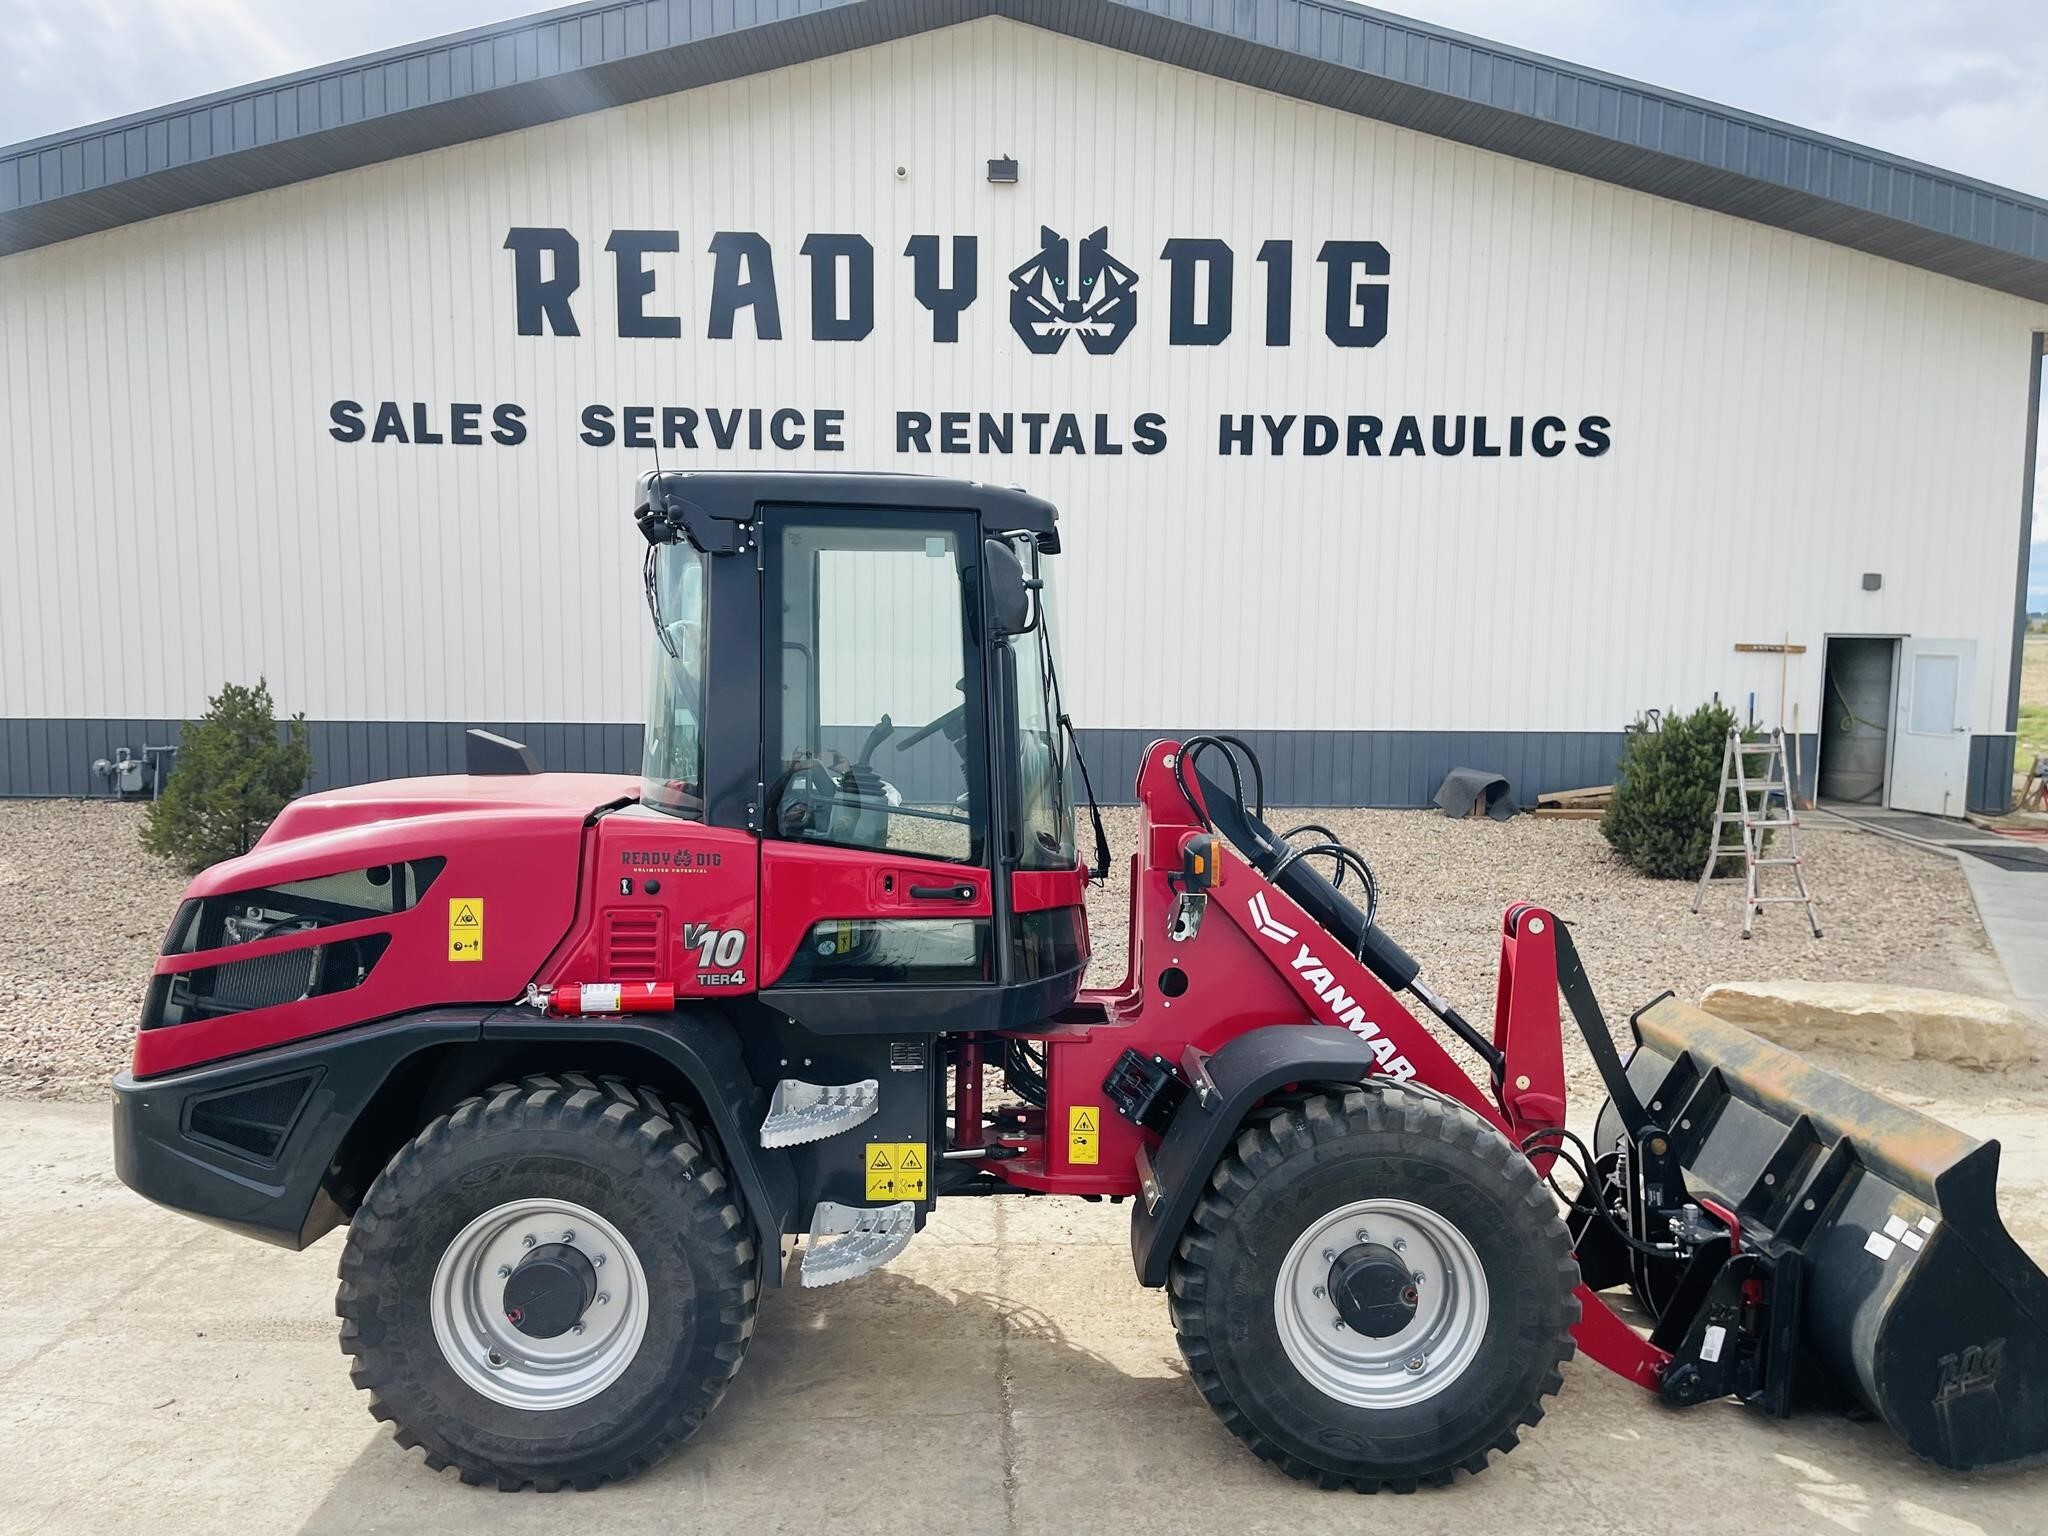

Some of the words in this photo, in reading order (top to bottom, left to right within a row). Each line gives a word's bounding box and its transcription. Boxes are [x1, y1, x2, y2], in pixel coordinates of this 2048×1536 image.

[503, 228, 977, 342] READY
[1160, 239, 1390, 348] DIG
[329, 401, 526, 446] SALES
[580, 405, 844, 451] SERVICE
[897, 412, 1167, 455] RENTALS
[1219, 415, 1611, 457] HYDRAULICS
[622, 851, 671, 865] READY
[696, 853, 721, 866] DIG
[683, 922, 747, 969] V10
[1290, 943, 1416, 1082] YANMAR
